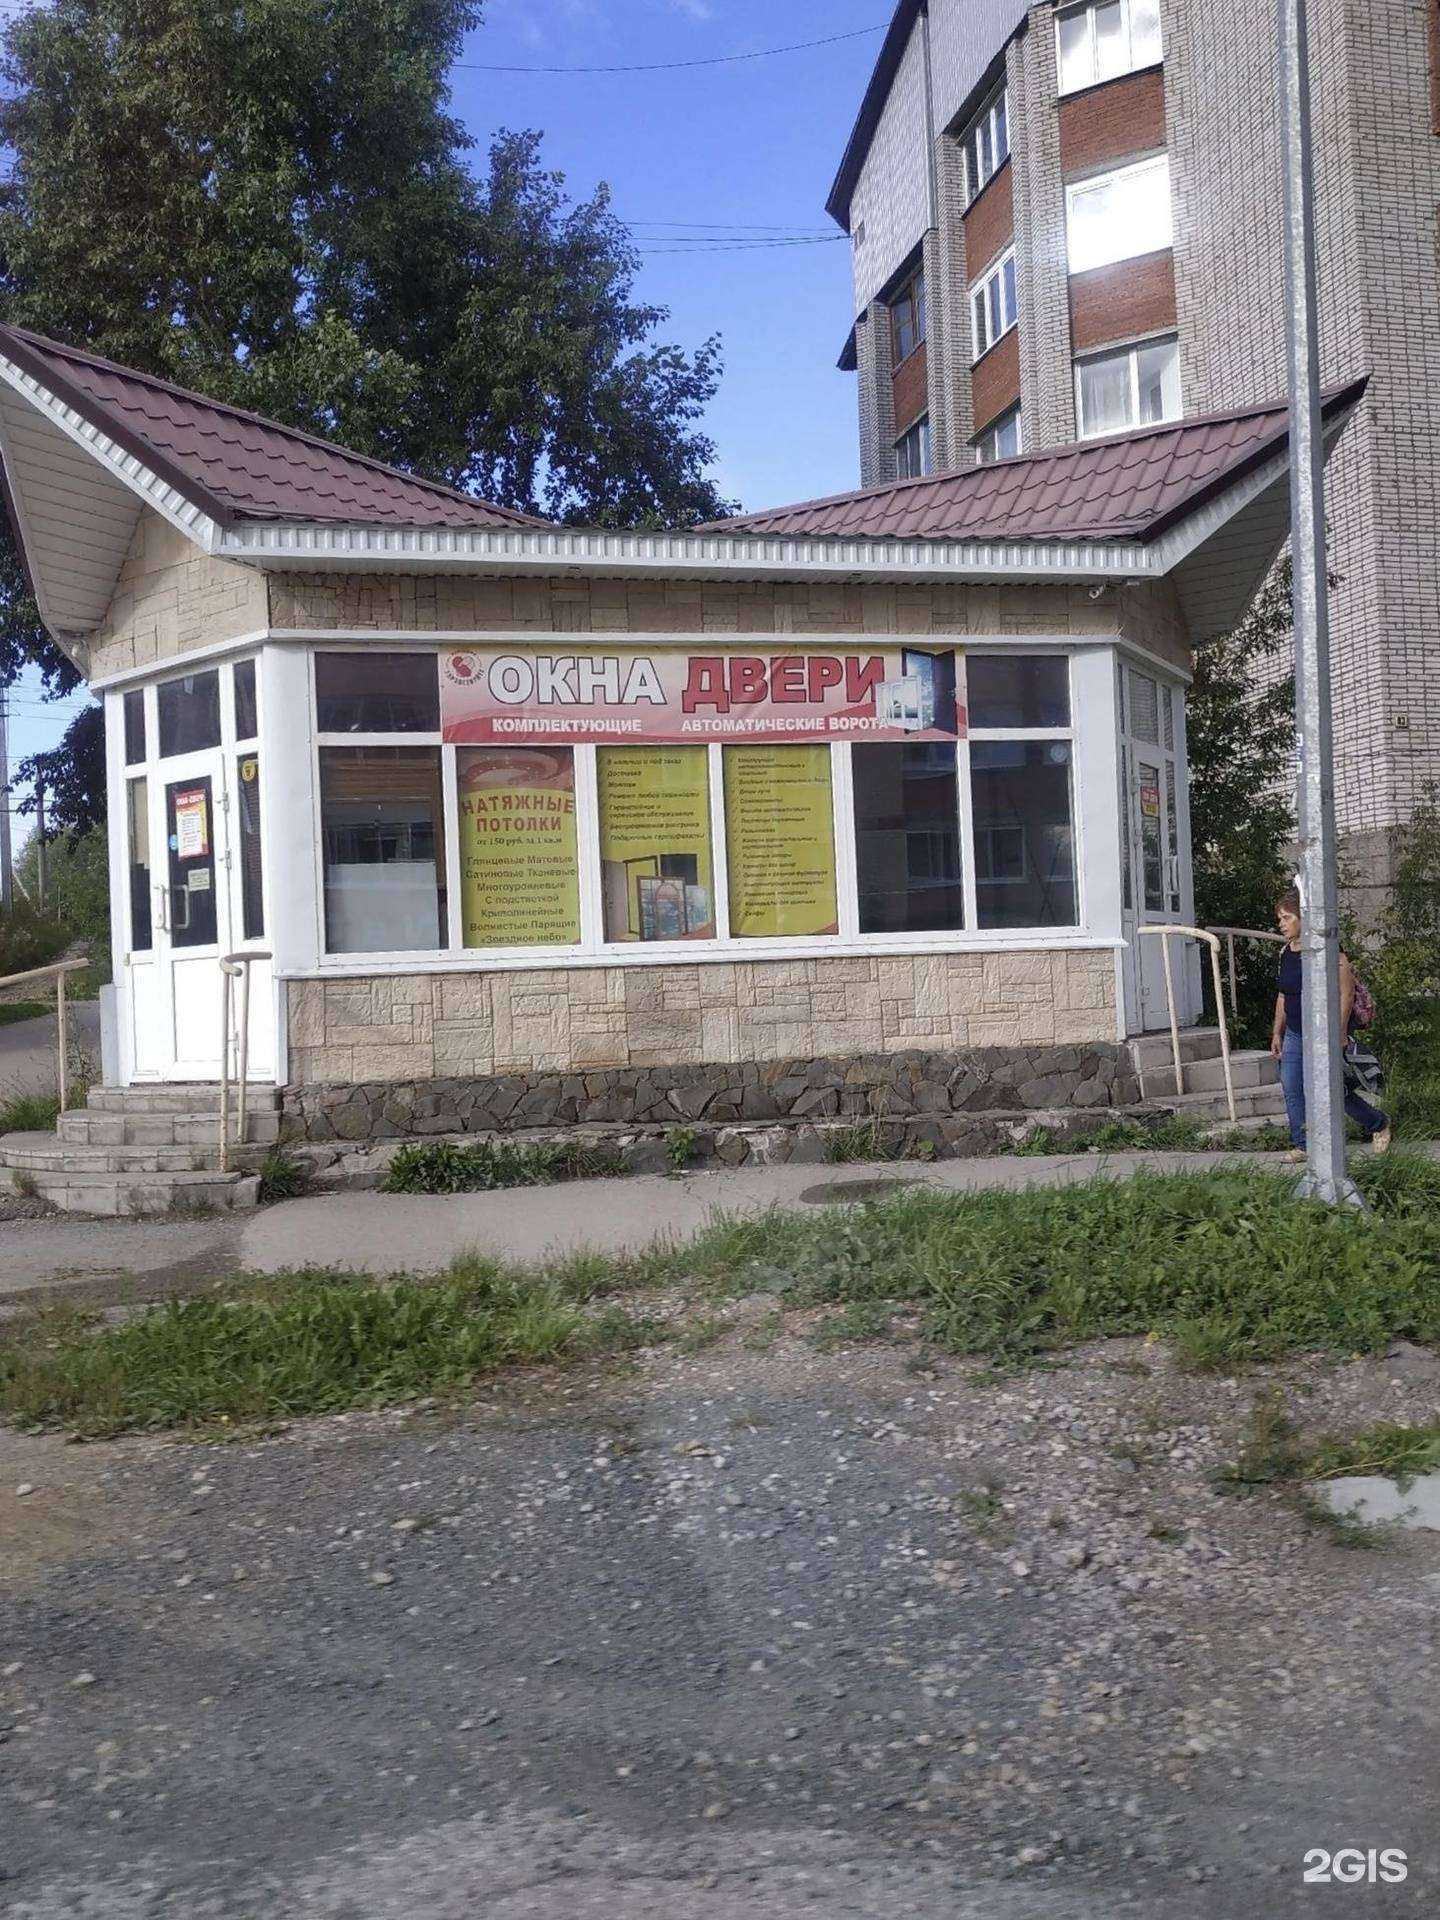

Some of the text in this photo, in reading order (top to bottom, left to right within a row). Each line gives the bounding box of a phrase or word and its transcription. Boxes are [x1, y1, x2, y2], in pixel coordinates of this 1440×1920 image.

[487, 655, 668, 705] ОКНА
[681, 656, 885, 713] ДВЕРИ
[492, 716, 889, 734] КОМПЛЕКТУЮЩИЕ АВТОМАТИЧЕСКИЕ ВОРОТА
[461, 794, 575, 816] НАТЯЖНЫЕ
[476, 816, 562, 833] ПОТОЛКИ
